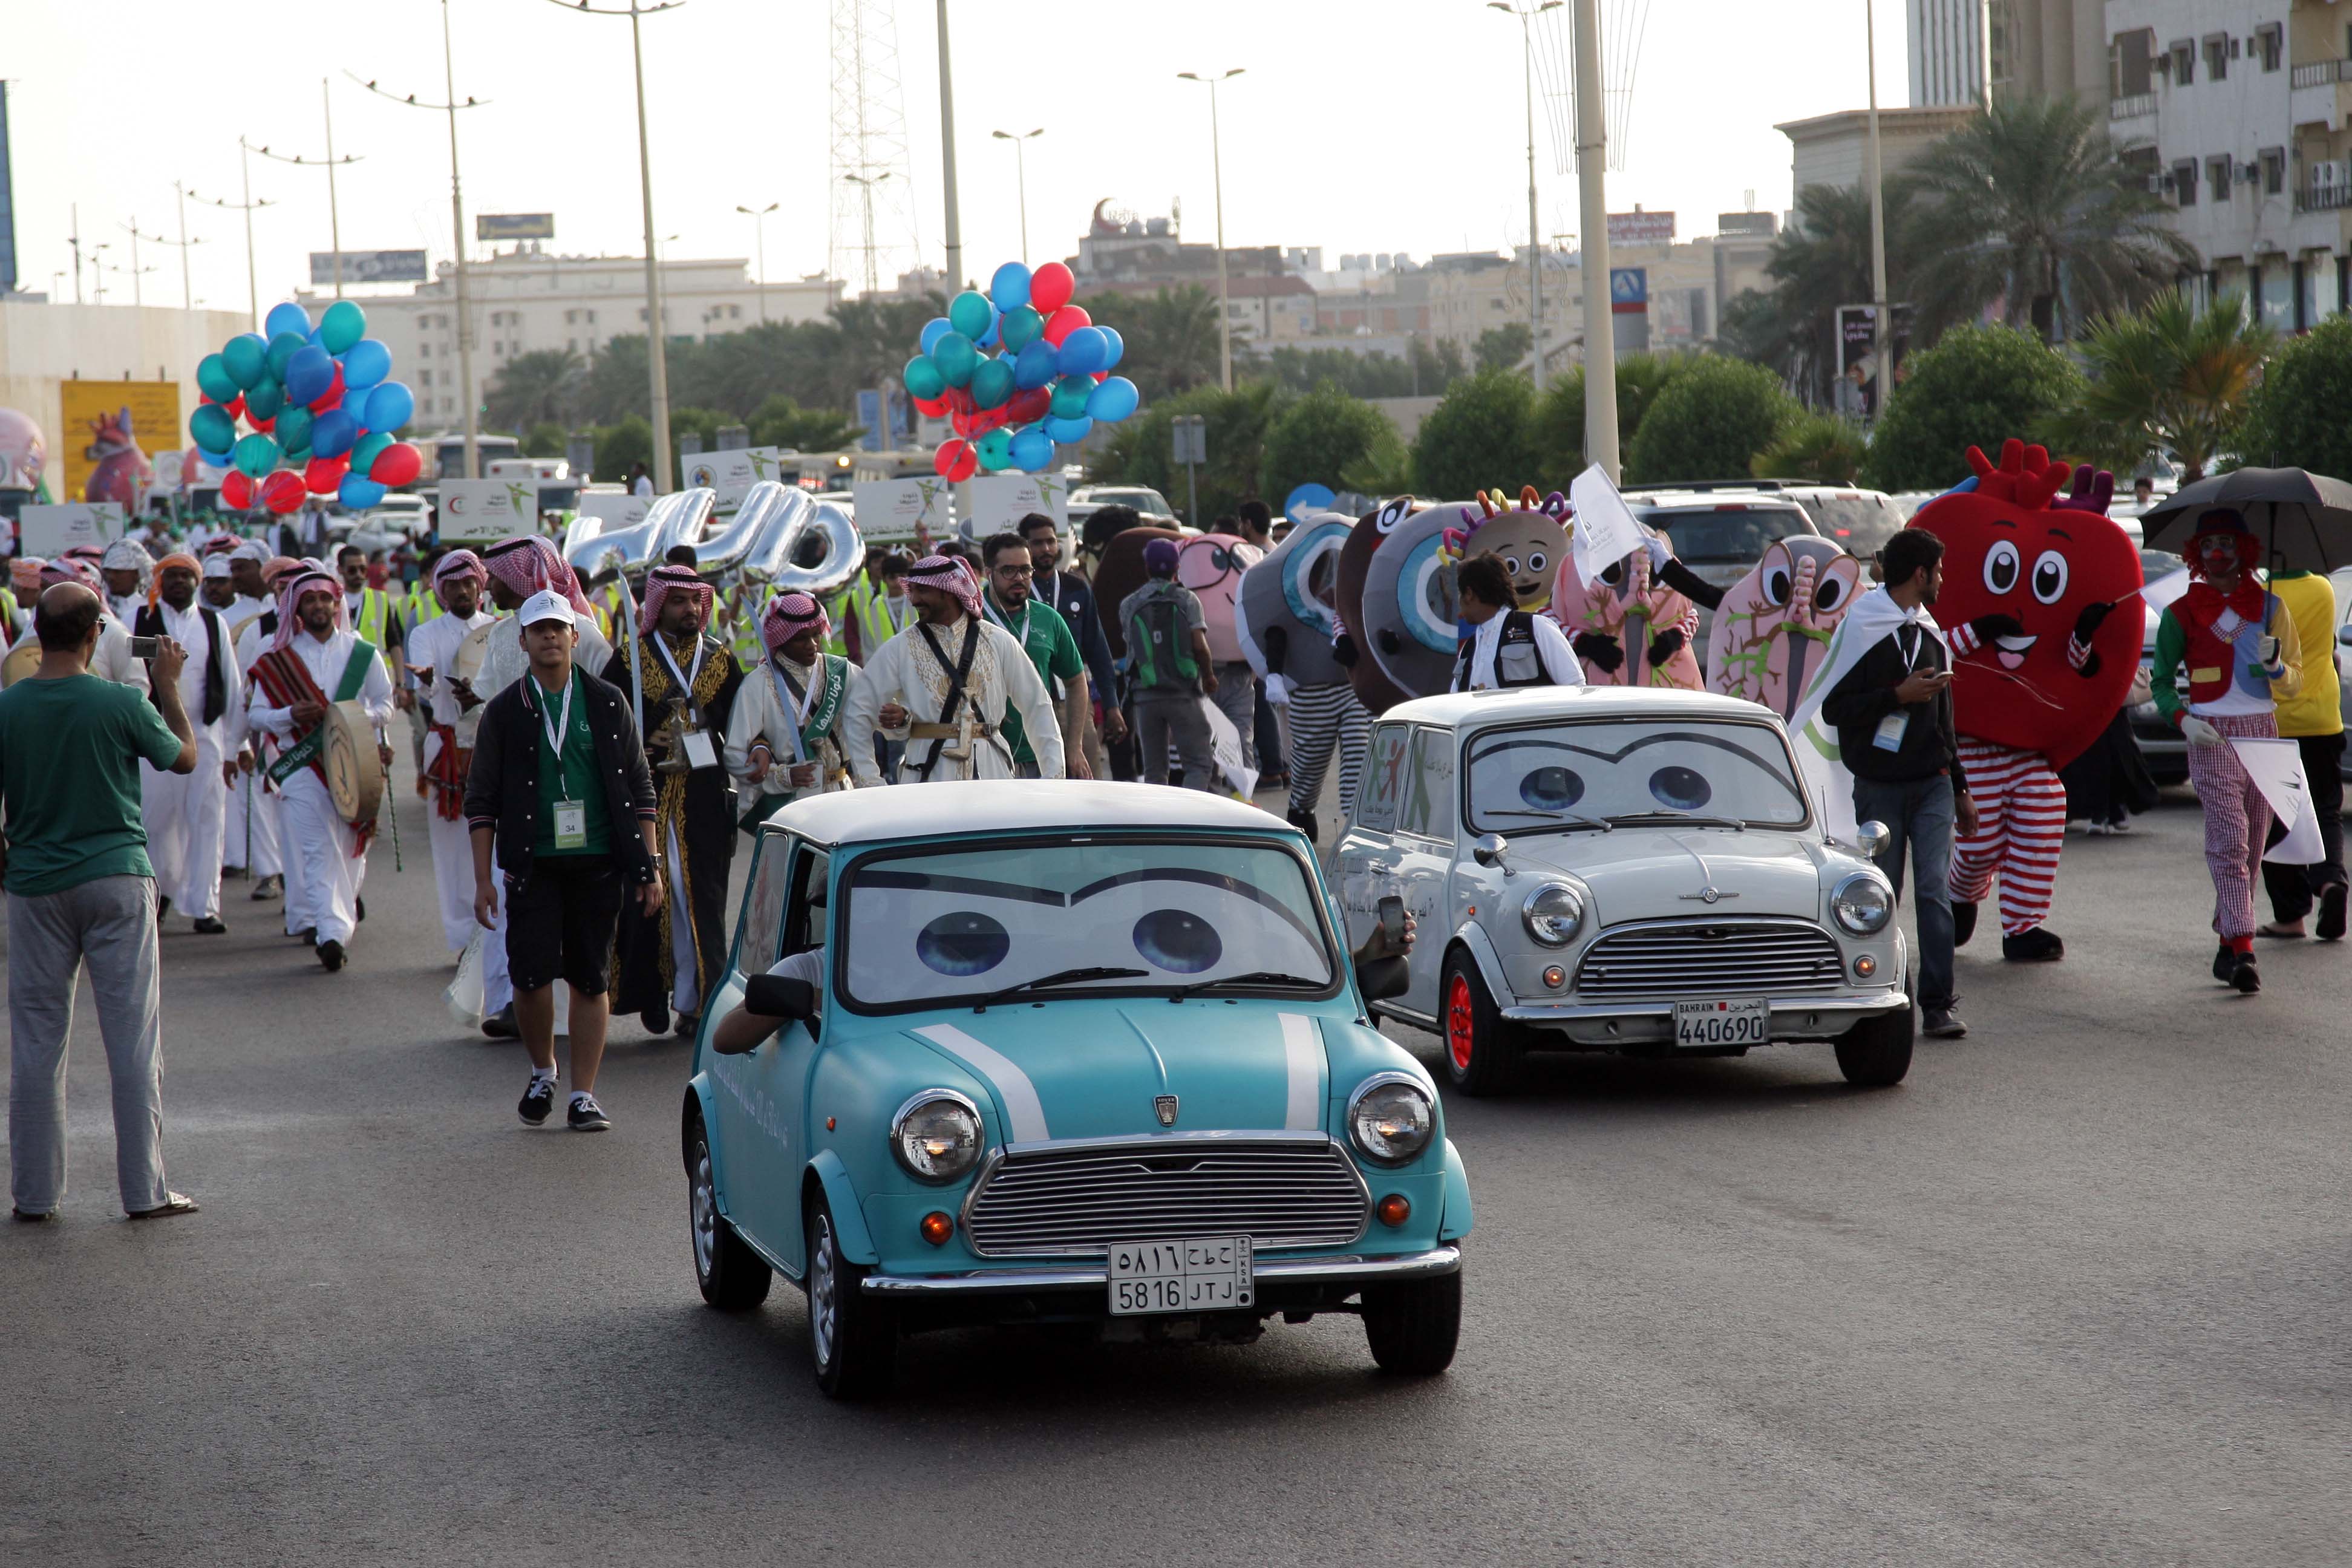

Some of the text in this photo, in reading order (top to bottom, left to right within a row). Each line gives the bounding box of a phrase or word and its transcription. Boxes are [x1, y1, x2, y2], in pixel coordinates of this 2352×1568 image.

[815, 673, 842, 731] خلونا نحييها
[1679, 1002, 1714, 1013] BAHRAIN
[1729, 1000, 1763, 1012] البحرين
[1679, 1016, 1763, 1044] 440690
[1119, 1279, 1180, 1309] 5816
